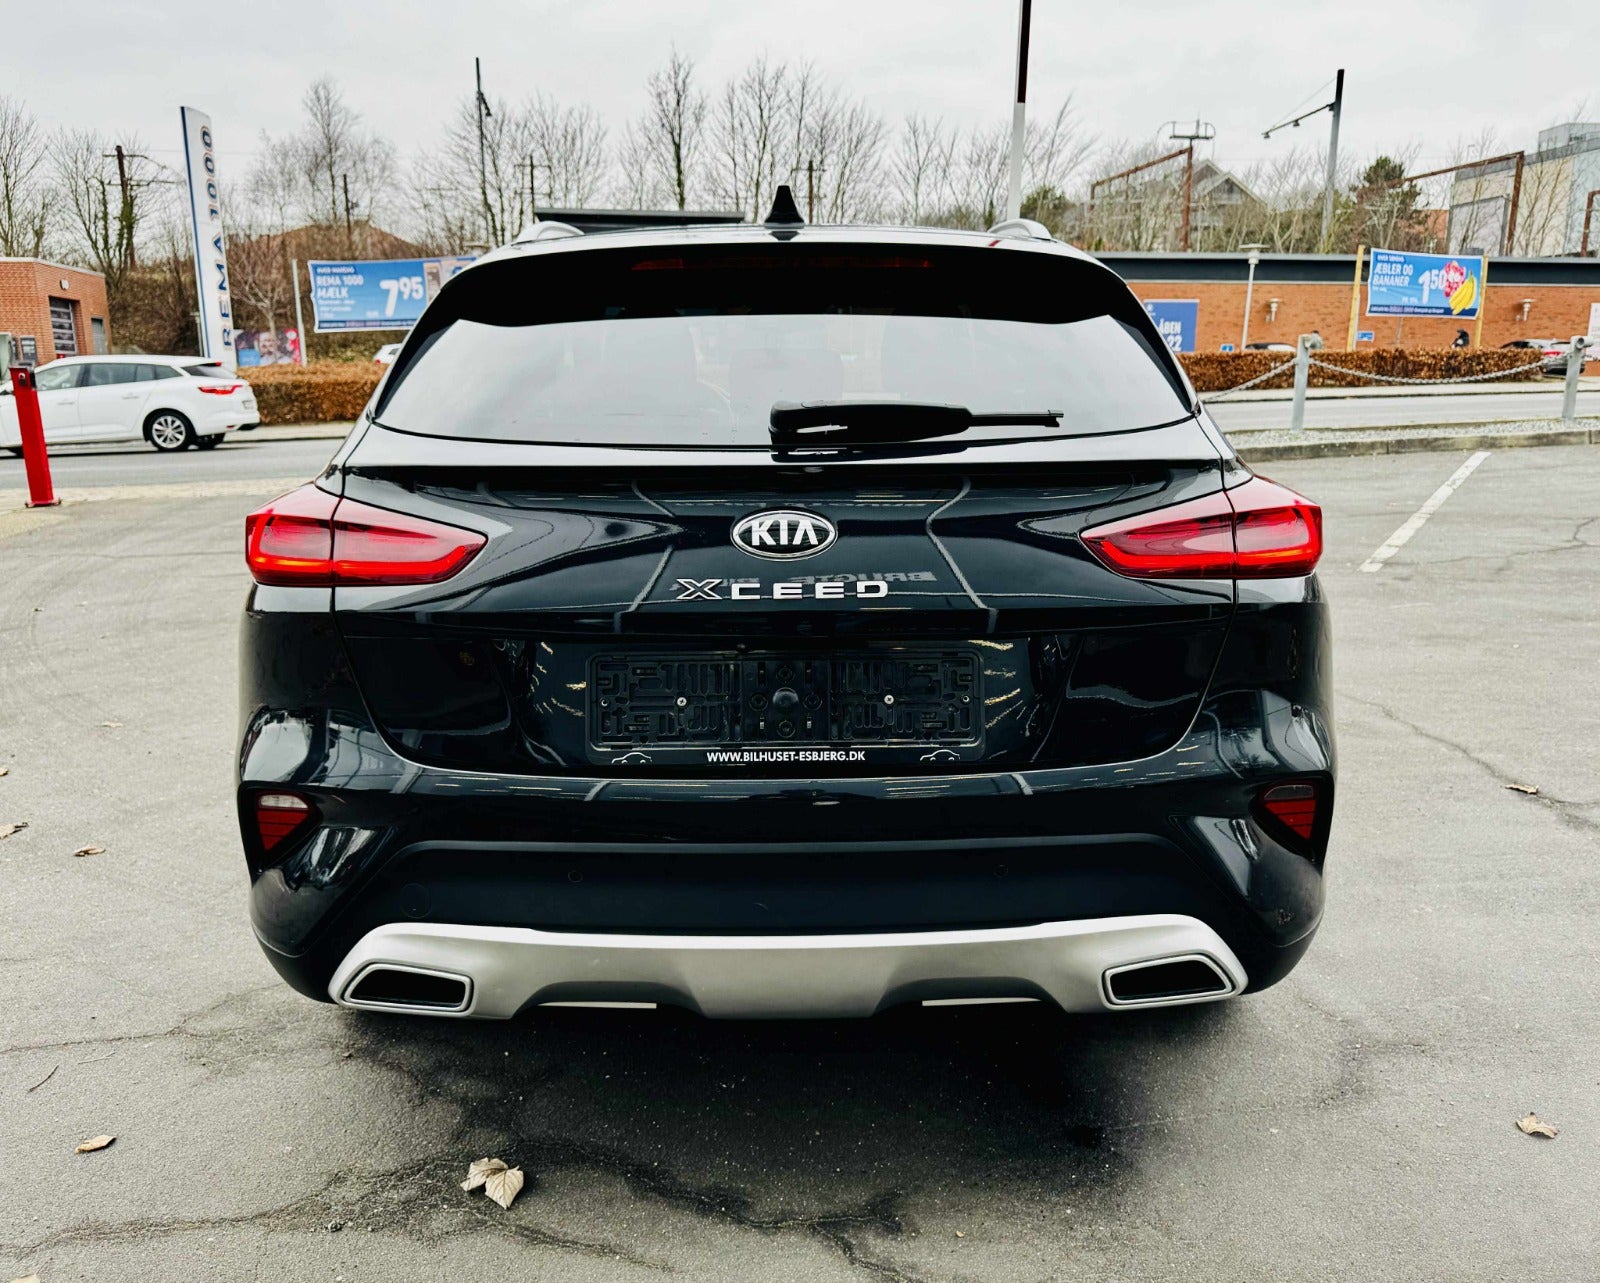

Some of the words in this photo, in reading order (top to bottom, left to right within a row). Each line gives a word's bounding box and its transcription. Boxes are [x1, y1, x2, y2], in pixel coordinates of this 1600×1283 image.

[200, 125, 221, 222] 1000
[1374, 262, 1401, 274] ÆBLER
[316, 275, 342, 286] REMA
[343, 274, 364, 286] 1000
[1372, 274, 1410, 287] BANANER
[213, 231, 232, 350] REMA
[316, 287, 349, 299] MÆLK
[751, 519, 819, 546] KIA
[675, 577, 889, 601] XCEED
[706, 750, 867, 763] WWW.BILHUSET-ESBJERG.DK
